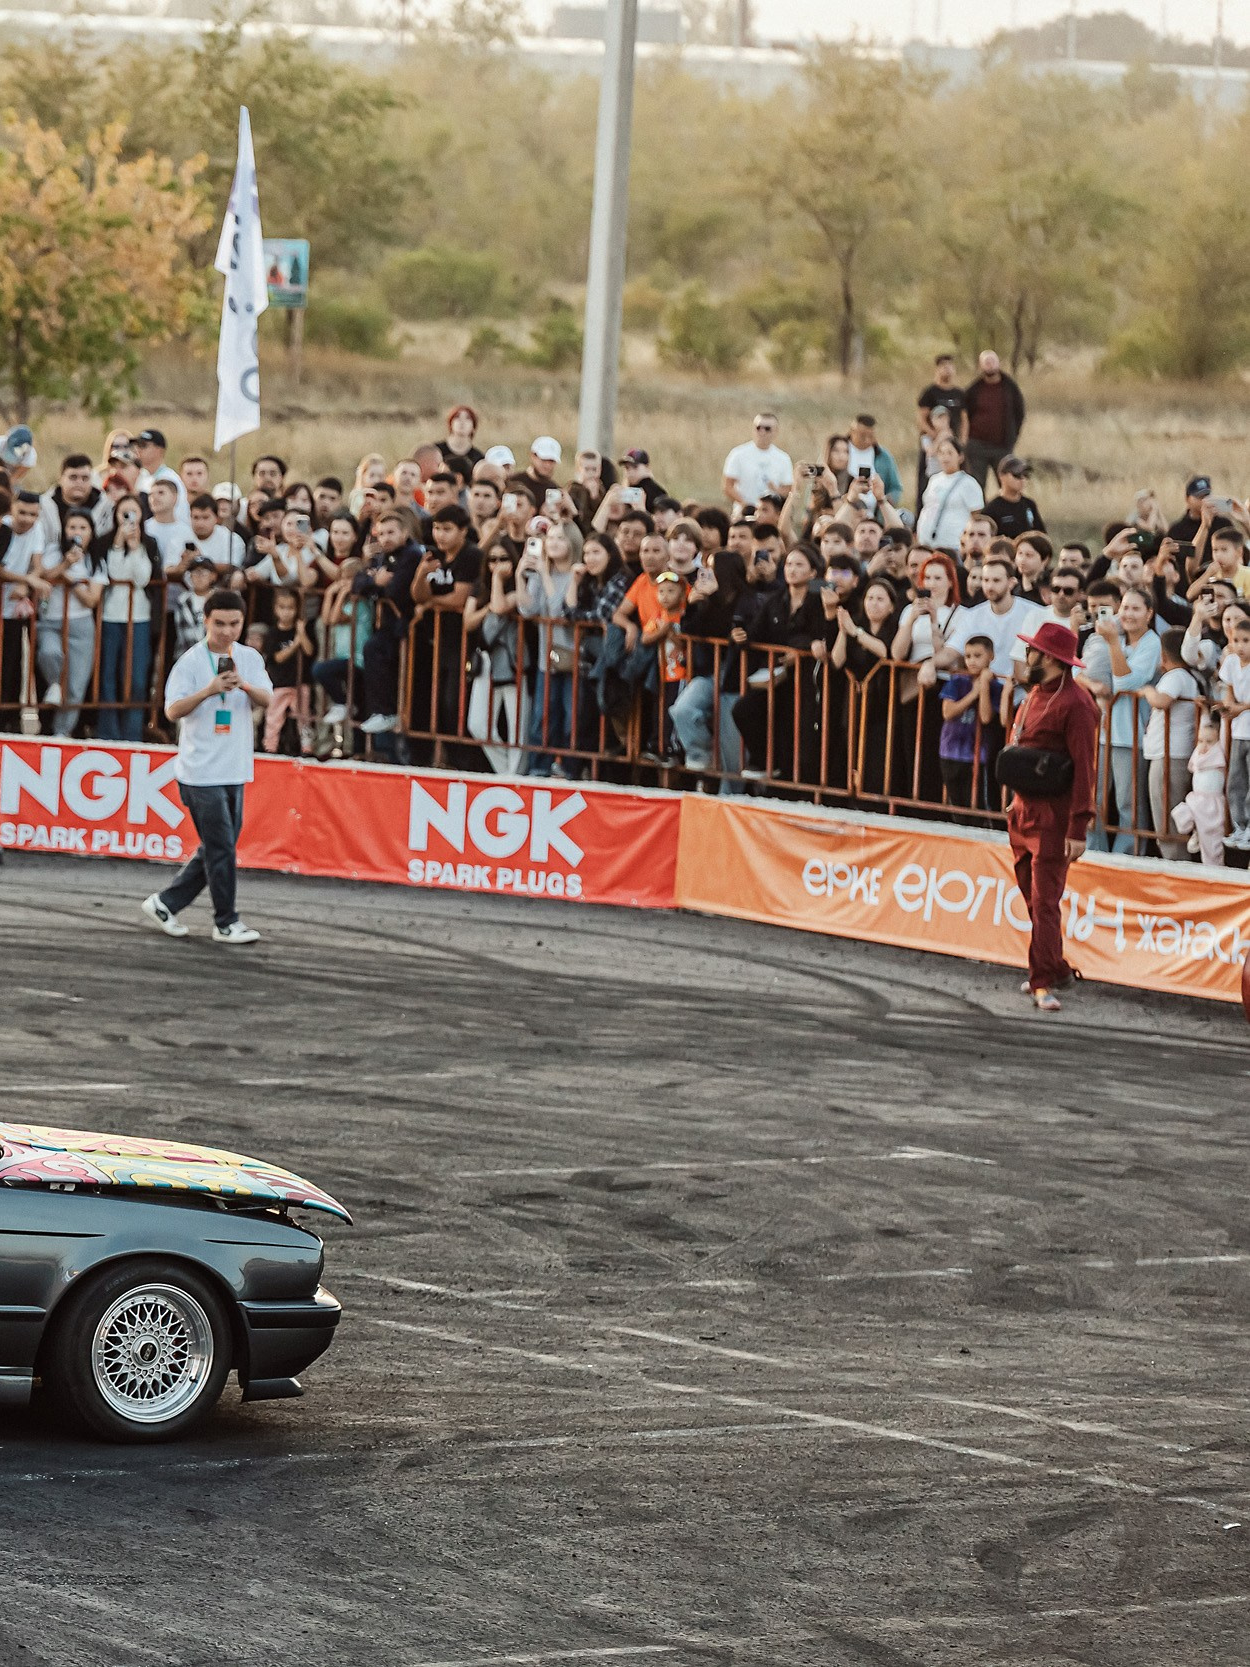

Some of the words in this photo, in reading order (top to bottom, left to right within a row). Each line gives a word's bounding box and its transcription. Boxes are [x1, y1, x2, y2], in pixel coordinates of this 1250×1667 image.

[0, 744, 186, 829] NGK
[91, 829, 183, 859] PLUGS
[408, 779, 588, 869] NGK
[407, 858, 492, 889] SPARK
[495, 867, 583, 898] PLUGS
